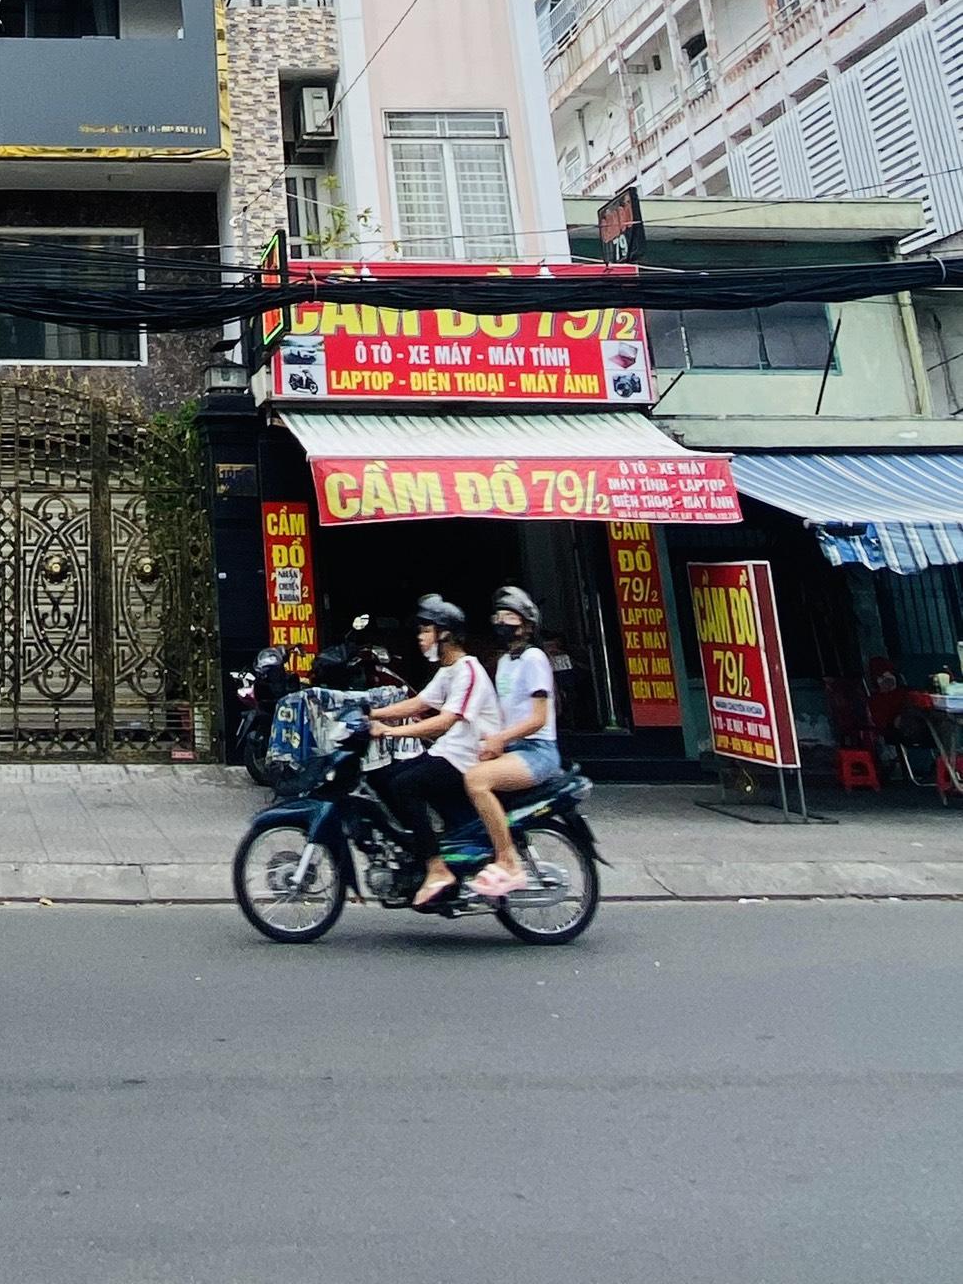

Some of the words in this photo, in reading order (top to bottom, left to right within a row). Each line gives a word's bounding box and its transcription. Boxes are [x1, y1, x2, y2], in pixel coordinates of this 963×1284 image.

[355, 341, 367, 363] Ô
[371, 341, 393, 364] TÔ
[408, 345, 430, 364] XE
[434, 342, 472, 365] MÁY
[488, 343, 525, 366] MÁY
[530, 343, 570, 366] TÍNH
[330, 370, 394, 391] LAPTOP
[410, 368, 451, 396] ĐIỆN
[454, 372, 504, 396] THOẠI
[520, 369, 558, 394] MÁY
[564, 368, 600, 394] ẢNH
[324, 460, 446, 520] CẦM
[453, 460, 528, 514] ĐỒ
[531, 470, 611, 514] 79/2
[678, 479, 726, 492] LAPTOP
[266, 506, 306, 536] CẦM
[272, 537, 305, 568] ĐỒ
[618, 543, 652, 572] ĐỒ
[619, 577, 659, 602] 79/2
[271, 603, 312, 621] LAPTOP
[621, 608, 663, 625] LAPTOP
[693, 569, 732, 644] CẦM
[729, 569, 757, 647] ĐỒ
[272, 626, 287, 644] XE
[289, 623, 315, 645] MÁY
[625, 631, 639, 648] XE
[642, 627, 668, 649] MÁY
[712, 651, 751, 697] 79/2
